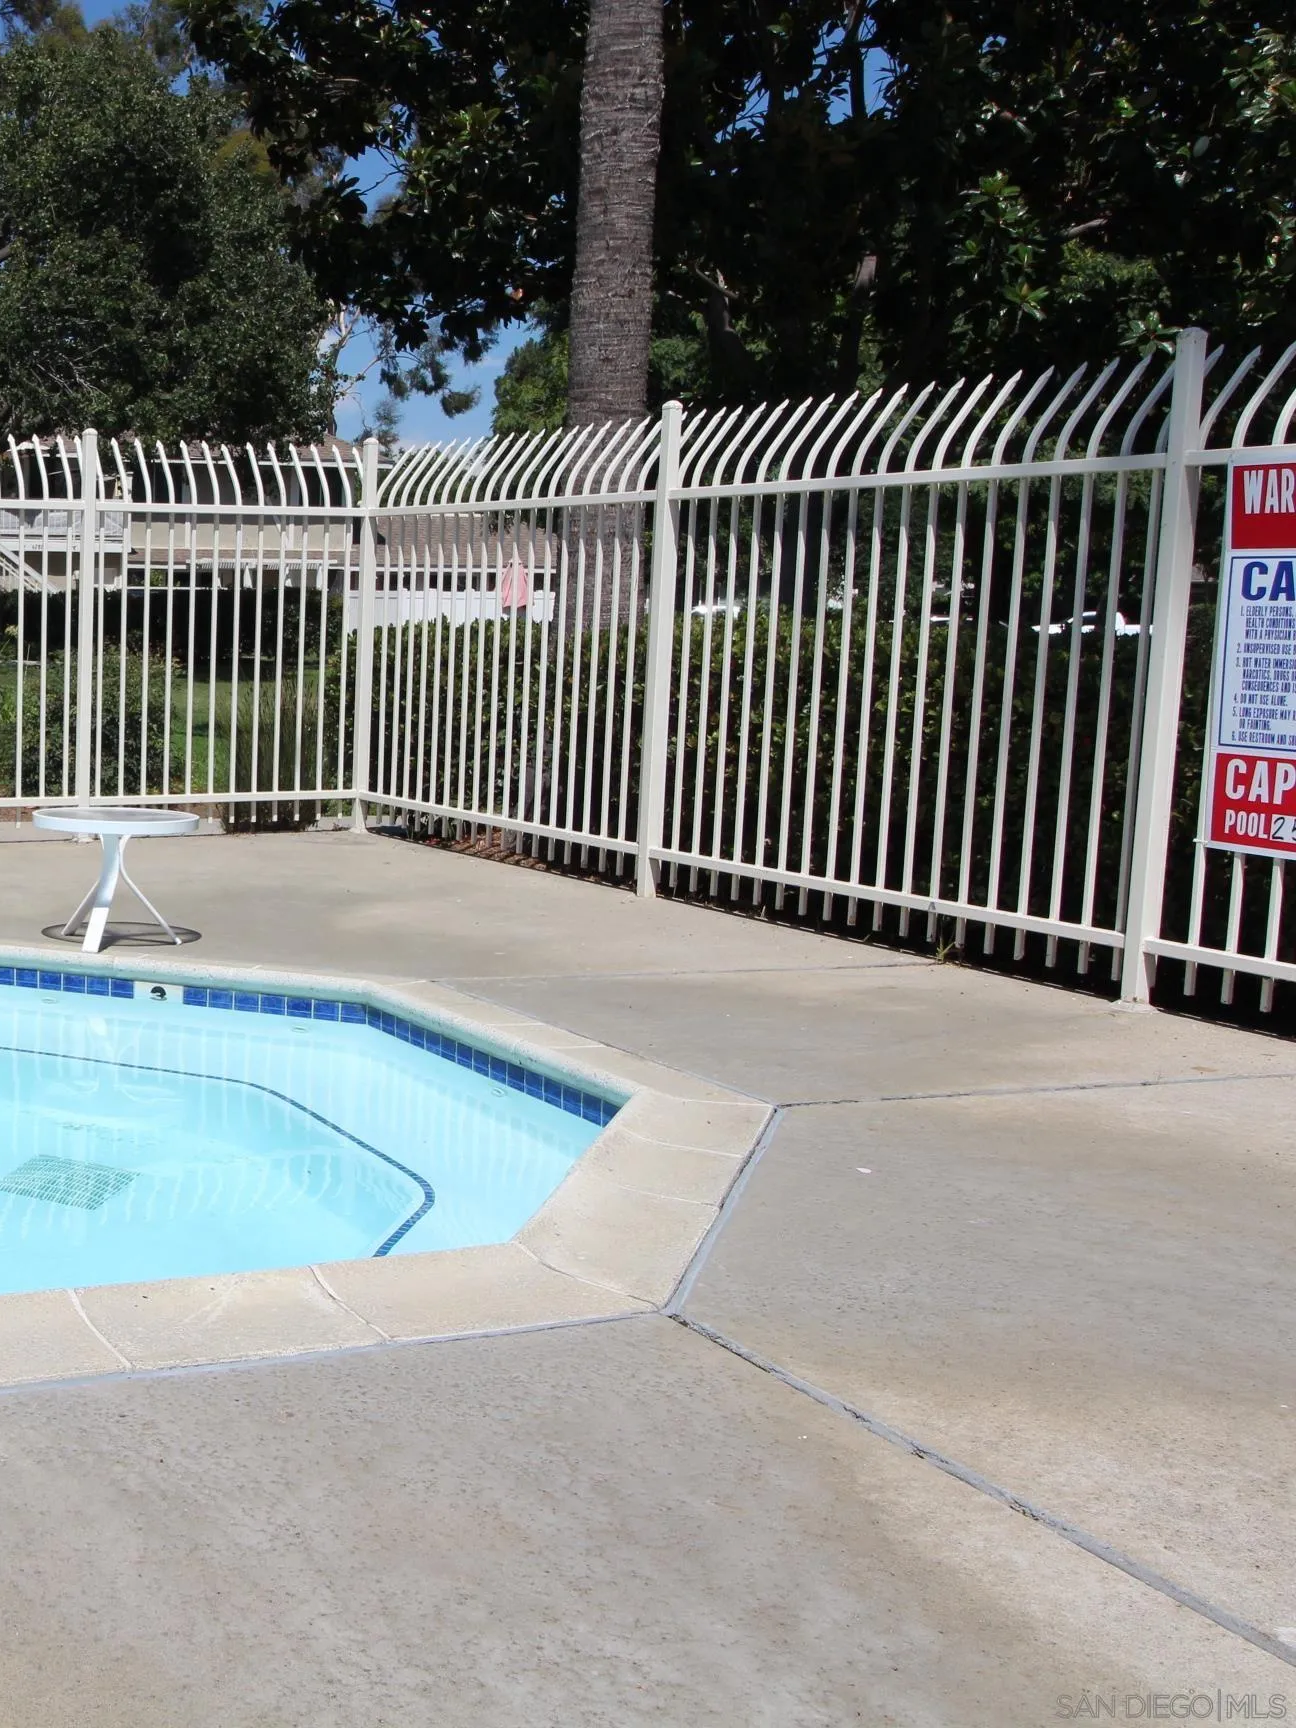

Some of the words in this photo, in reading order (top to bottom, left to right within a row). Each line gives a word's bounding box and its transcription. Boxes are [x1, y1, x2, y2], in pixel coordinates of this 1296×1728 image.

[1243, 468, 1296, 514] WAR
[1241, 561, 1296, 602] CA
[1246, 606, 1268, 617] ELDERLY
[1245, 617, 1265, 628] HEALTH
[1265, 618, 1296, 629] CONDITIONS
[1245, 629, 1258, 640] WITH
[1264, 629, 1292, 640] PHYSICIAN
[1244, 643, 1281, 654] UNSUPERVISED
[1282, 644, 1292, 655] USE
[1242, 657, 1252, 668] HOT
[1253, 657, 1271, 669] WATER
[1273, 670, 1290, 681] DRUGS
[1241, 681, 1279, 692] CONSEQUENCES
[1280, 682, 1291, 693] AND
[1240, 694, 1246, 704] DO
[1247, 694, 1258, 705] NOT
[1259, 694, 1269, 706] USE
[1239, 706, 1252, 718] LONG
[1252, 707, 1279, 719] EXPOSURE
[1280, 709, 1291, 721] MAY
[1239, 718, 1246, 729] OR
[1238, 731, 1248, 742] USE
[1249, 732, 1275, 743] RESTROOM
[1277, 733, 1287, 745] AND
[1225, 758, 1296, 805] CAP
[1224, 809, 1268, 839] POOL
